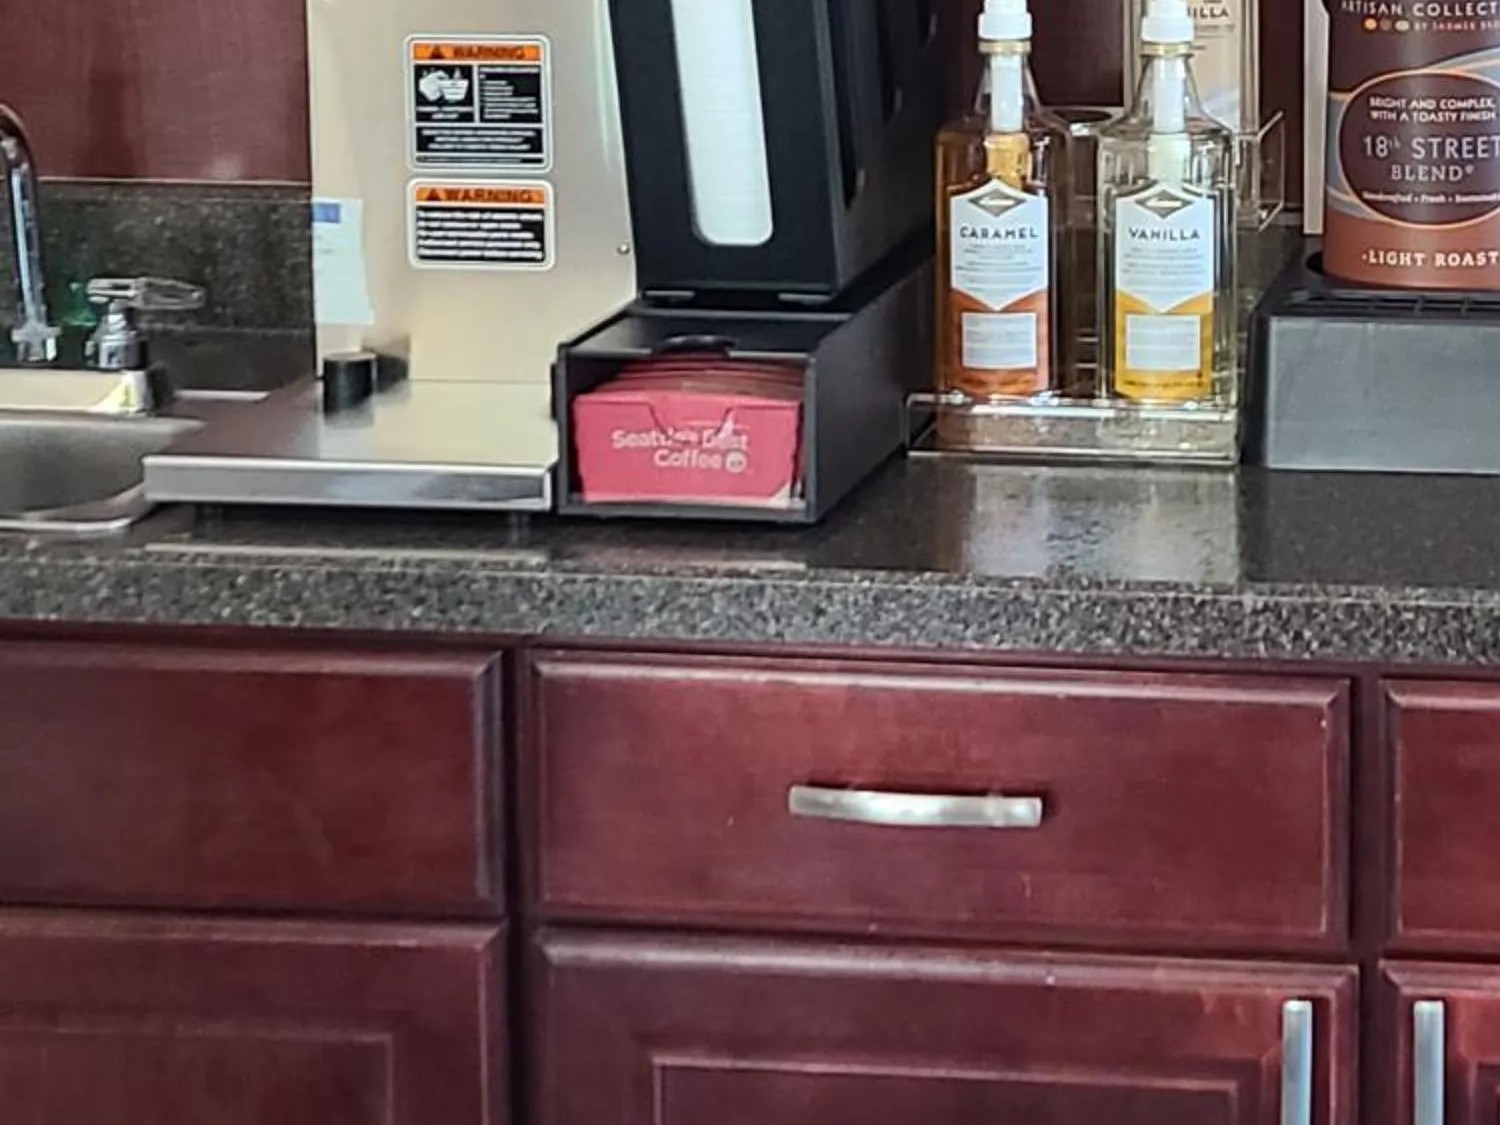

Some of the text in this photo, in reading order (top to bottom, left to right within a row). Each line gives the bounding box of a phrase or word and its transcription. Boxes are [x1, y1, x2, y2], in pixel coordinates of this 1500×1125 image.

[1341, 0, 1402, 16] ARTISAN
[1369, 96, 1406, 109] BRIGHT
[1409, 98, 1436, 110] AND
[1370, 110, 1497, 123] WITH A TOASTY FINISH
[959, 226, 1039, 240] CARAMEL
[1128, 228, 1201, 241] VANILLA
[654, 450, 722, 469] Coffee
